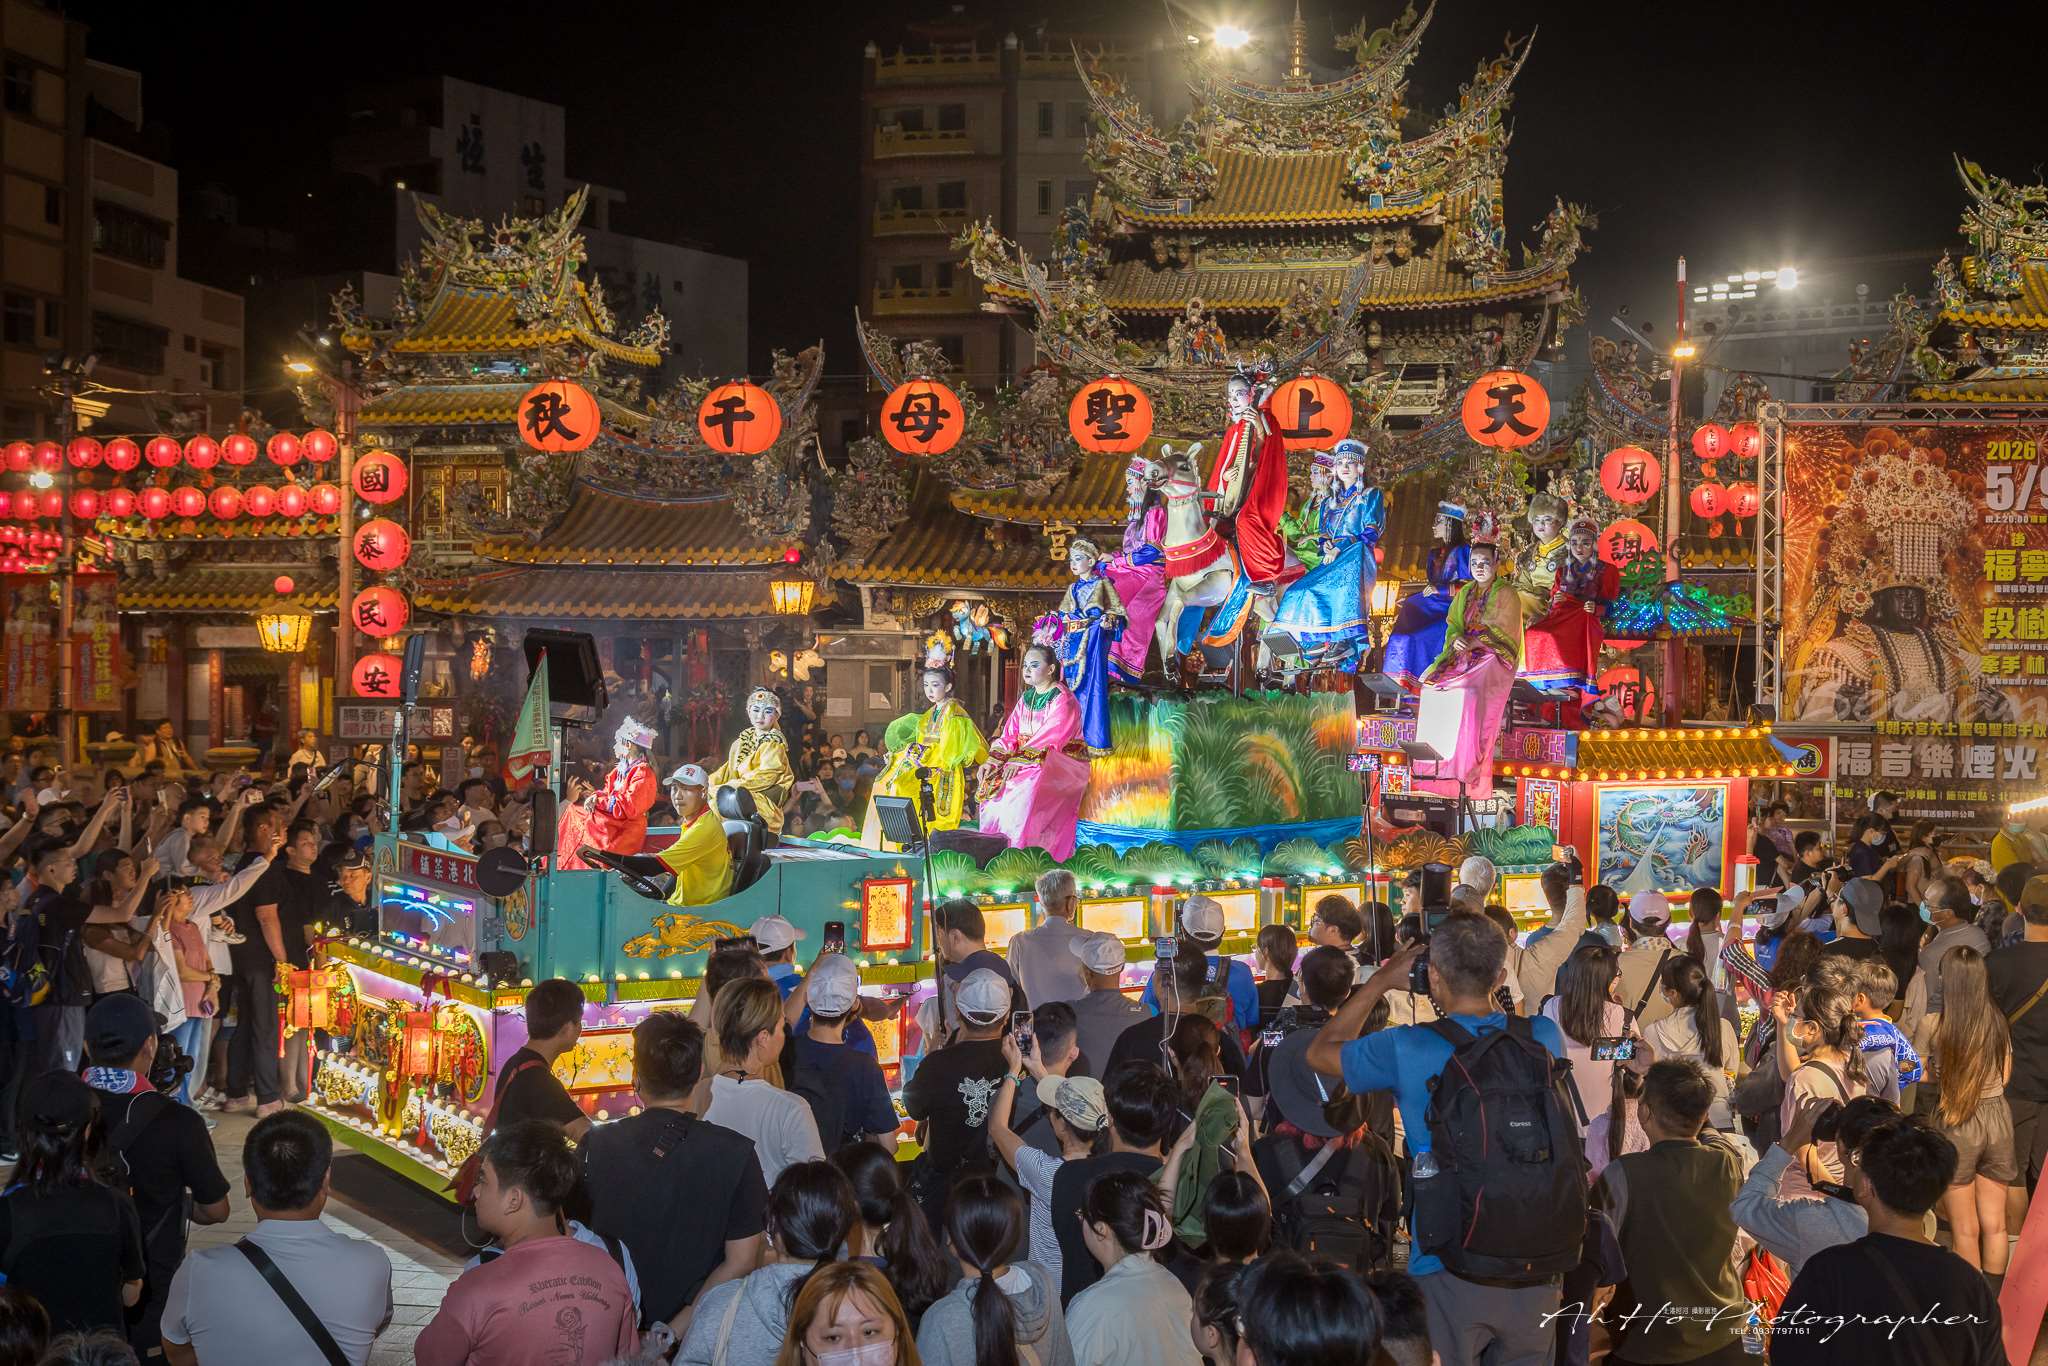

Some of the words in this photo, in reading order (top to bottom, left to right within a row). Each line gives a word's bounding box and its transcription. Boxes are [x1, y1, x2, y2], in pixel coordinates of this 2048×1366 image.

[525, 392, 580, 442] 秋
[890, 392, 952, 443] 母
[1084, 388, 1136, 440] 聖
[1282, 391, 1333, 438] 上
[1479, 384, 1538, 437] 天
[1986, 442, 2036, 460] 2026
[360, 463, 389, 493] 國
[1617, 462, 1649, 493] 風
[358, 533, 385, 560] 泰
[1043, 520, 1077, 560] 宮
[1609, 532, 1643, 561] 調
[1983, 549, 2048, 582] 福寧
[358, 600, 387, 628] 民
[361, 667, 391, 694] 安
[1839, 742, 2037, 780] 福音樂煙火
